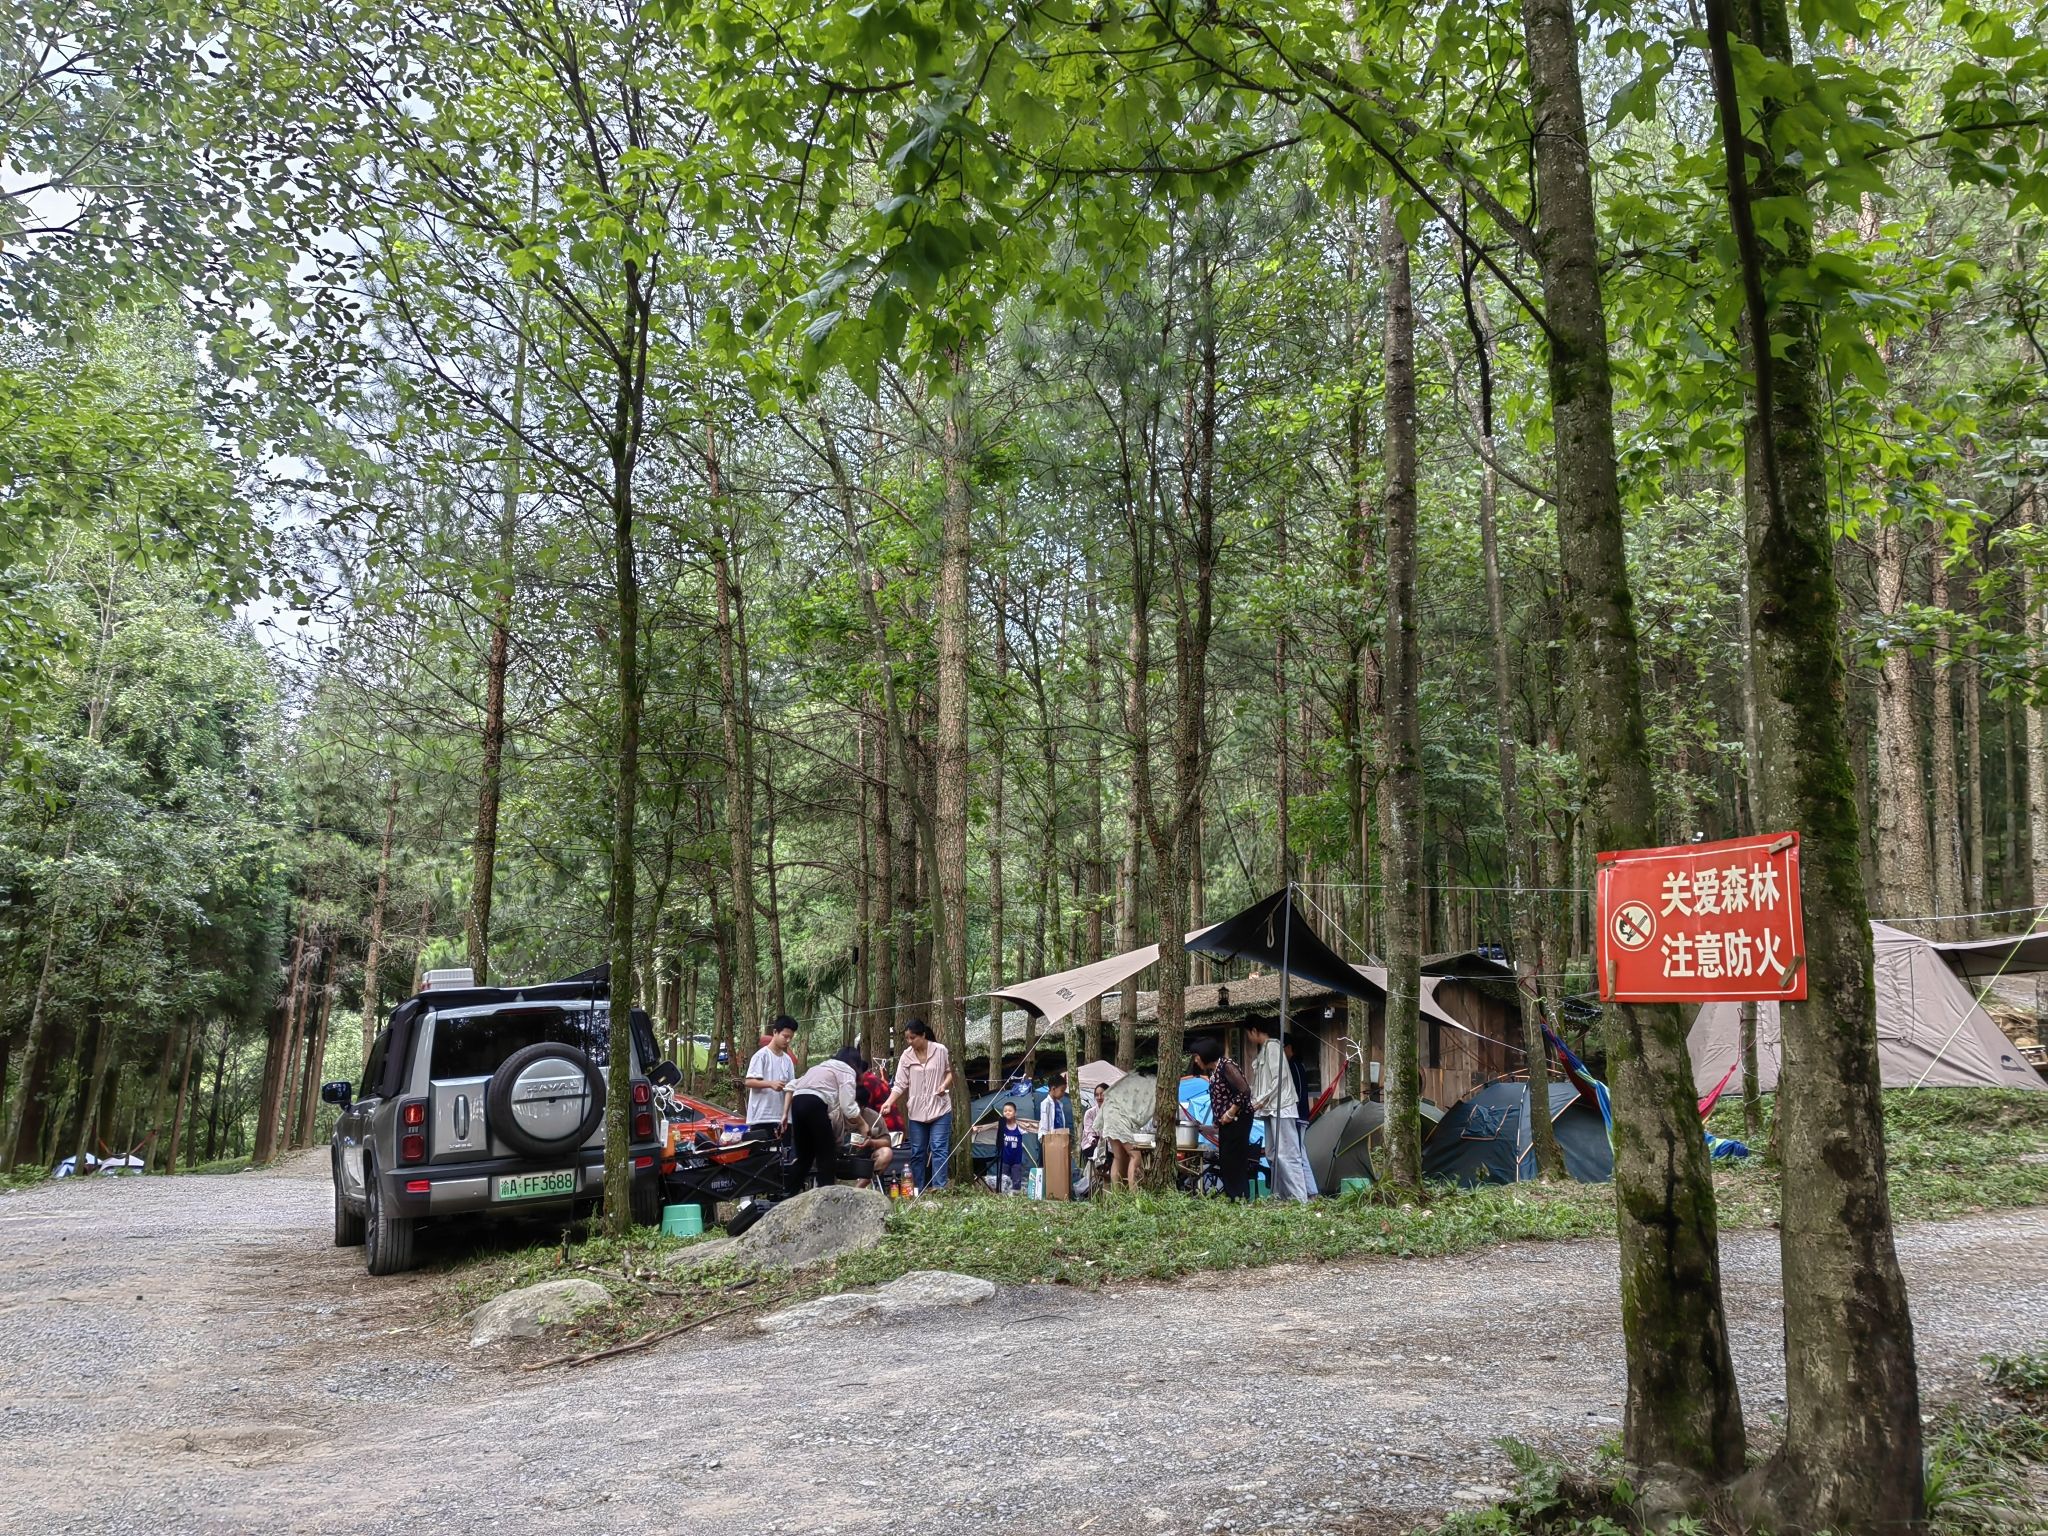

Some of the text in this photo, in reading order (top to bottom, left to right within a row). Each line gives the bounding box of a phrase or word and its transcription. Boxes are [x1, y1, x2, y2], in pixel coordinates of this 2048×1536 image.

[1660, 861, 1781, 918] 关爱森林
[1660, 927, 1786, 979] 注意防火
